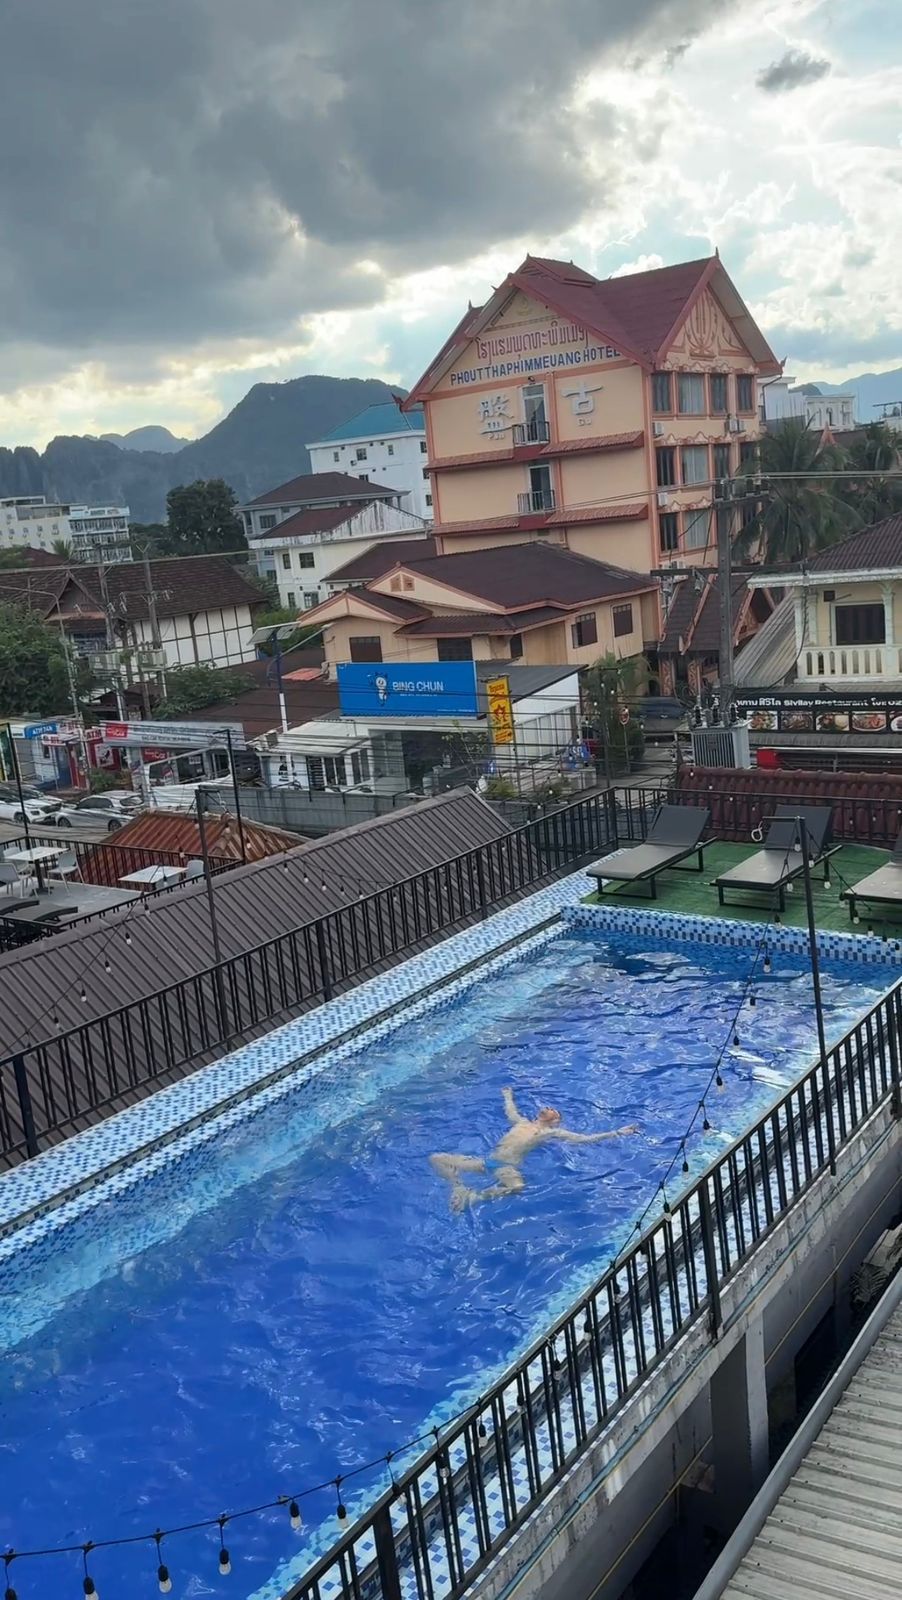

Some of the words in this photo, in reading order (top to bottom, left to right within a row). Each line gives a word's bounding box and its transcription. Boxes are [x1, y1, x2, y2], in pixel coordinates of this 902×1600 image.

[450, 351, 581, 386] PHOUTTHAPHIMMEUANG
[583, 345, 621, 363] HOTEL
[561, 382, 604, 416] 古
[392, 681, 415, 691] BING
[416, 681, 444, 692] CHUN
